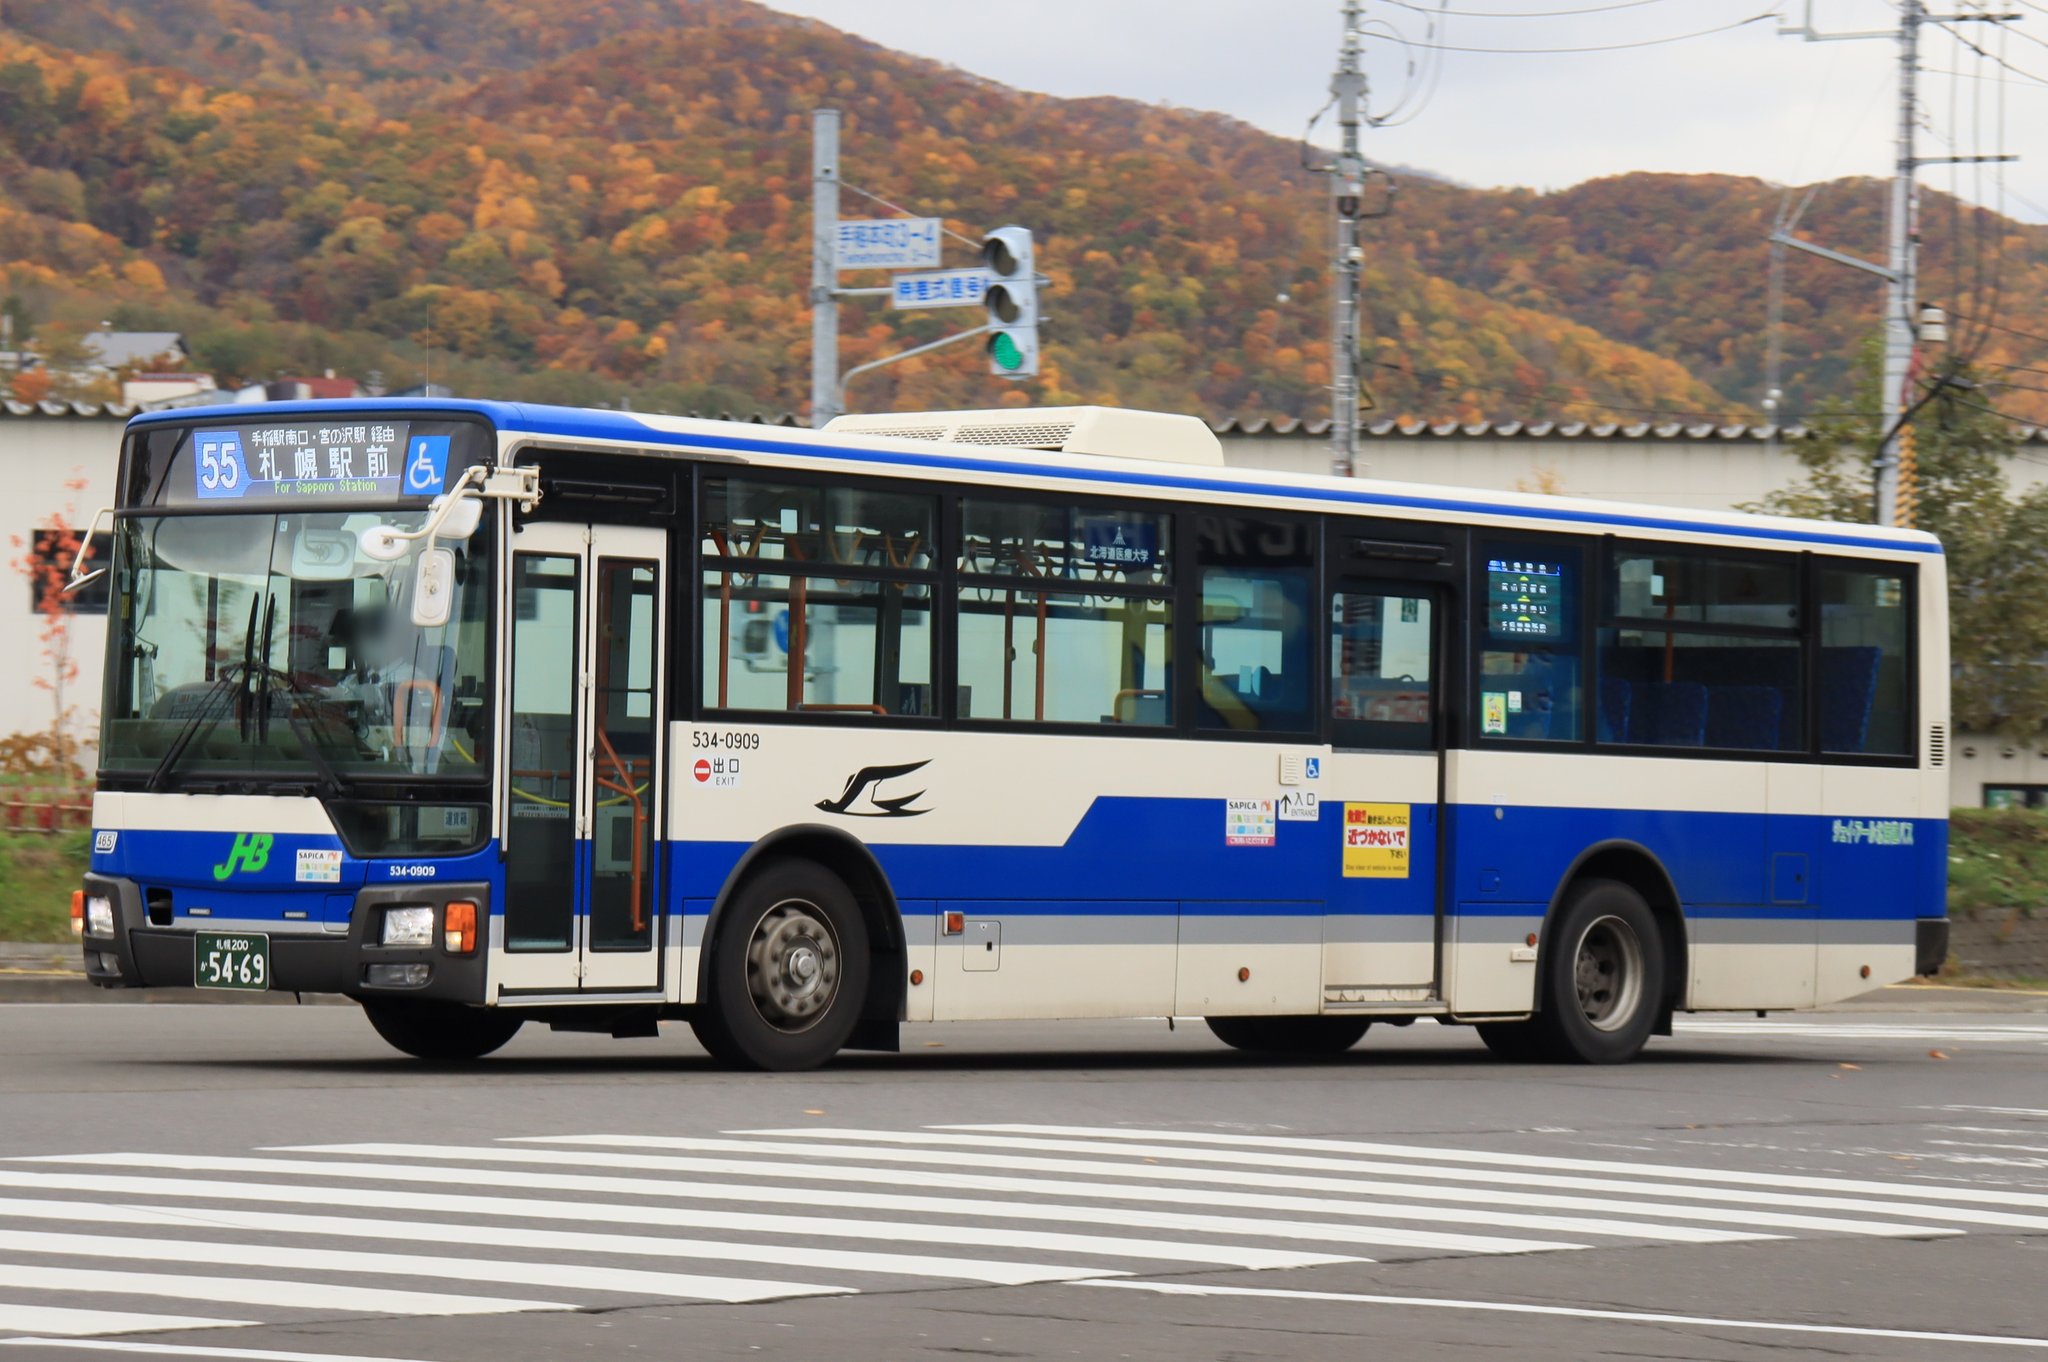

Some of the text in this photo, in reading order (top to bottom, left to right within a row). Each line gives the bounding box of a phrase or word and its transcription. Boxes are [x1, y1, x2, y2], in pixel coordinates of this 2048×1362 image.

[251, 425, 395, 447] 手稲駅南口・宮の沢駅 経由
[201, 442, 238, 490] 55
[259, 445, 388, 480] 札幌駅前
[274, 479, 377, 496] For Sapporo Station
[1089, 545, 1149, 563] 北海道医療大学
[692, 731, 760, 750] 534-0909
[713, 757, 740, 774] 出口
[715, 776, 736, 786] EXIT
[1229, 801, 1257, 810] SAPICA
[1294, 792, 1315, 806] 入口
[1290, 809, 1318, 817] ENTRANCE
[97, 834, 112, 847] 465
[1348, 828, 1406, 846] 近づかないで
[298, 852, 324, 860] SAPICA
[389, 864, 436, 877] 534-0909
[209, 951, 265, 985] 54-69
